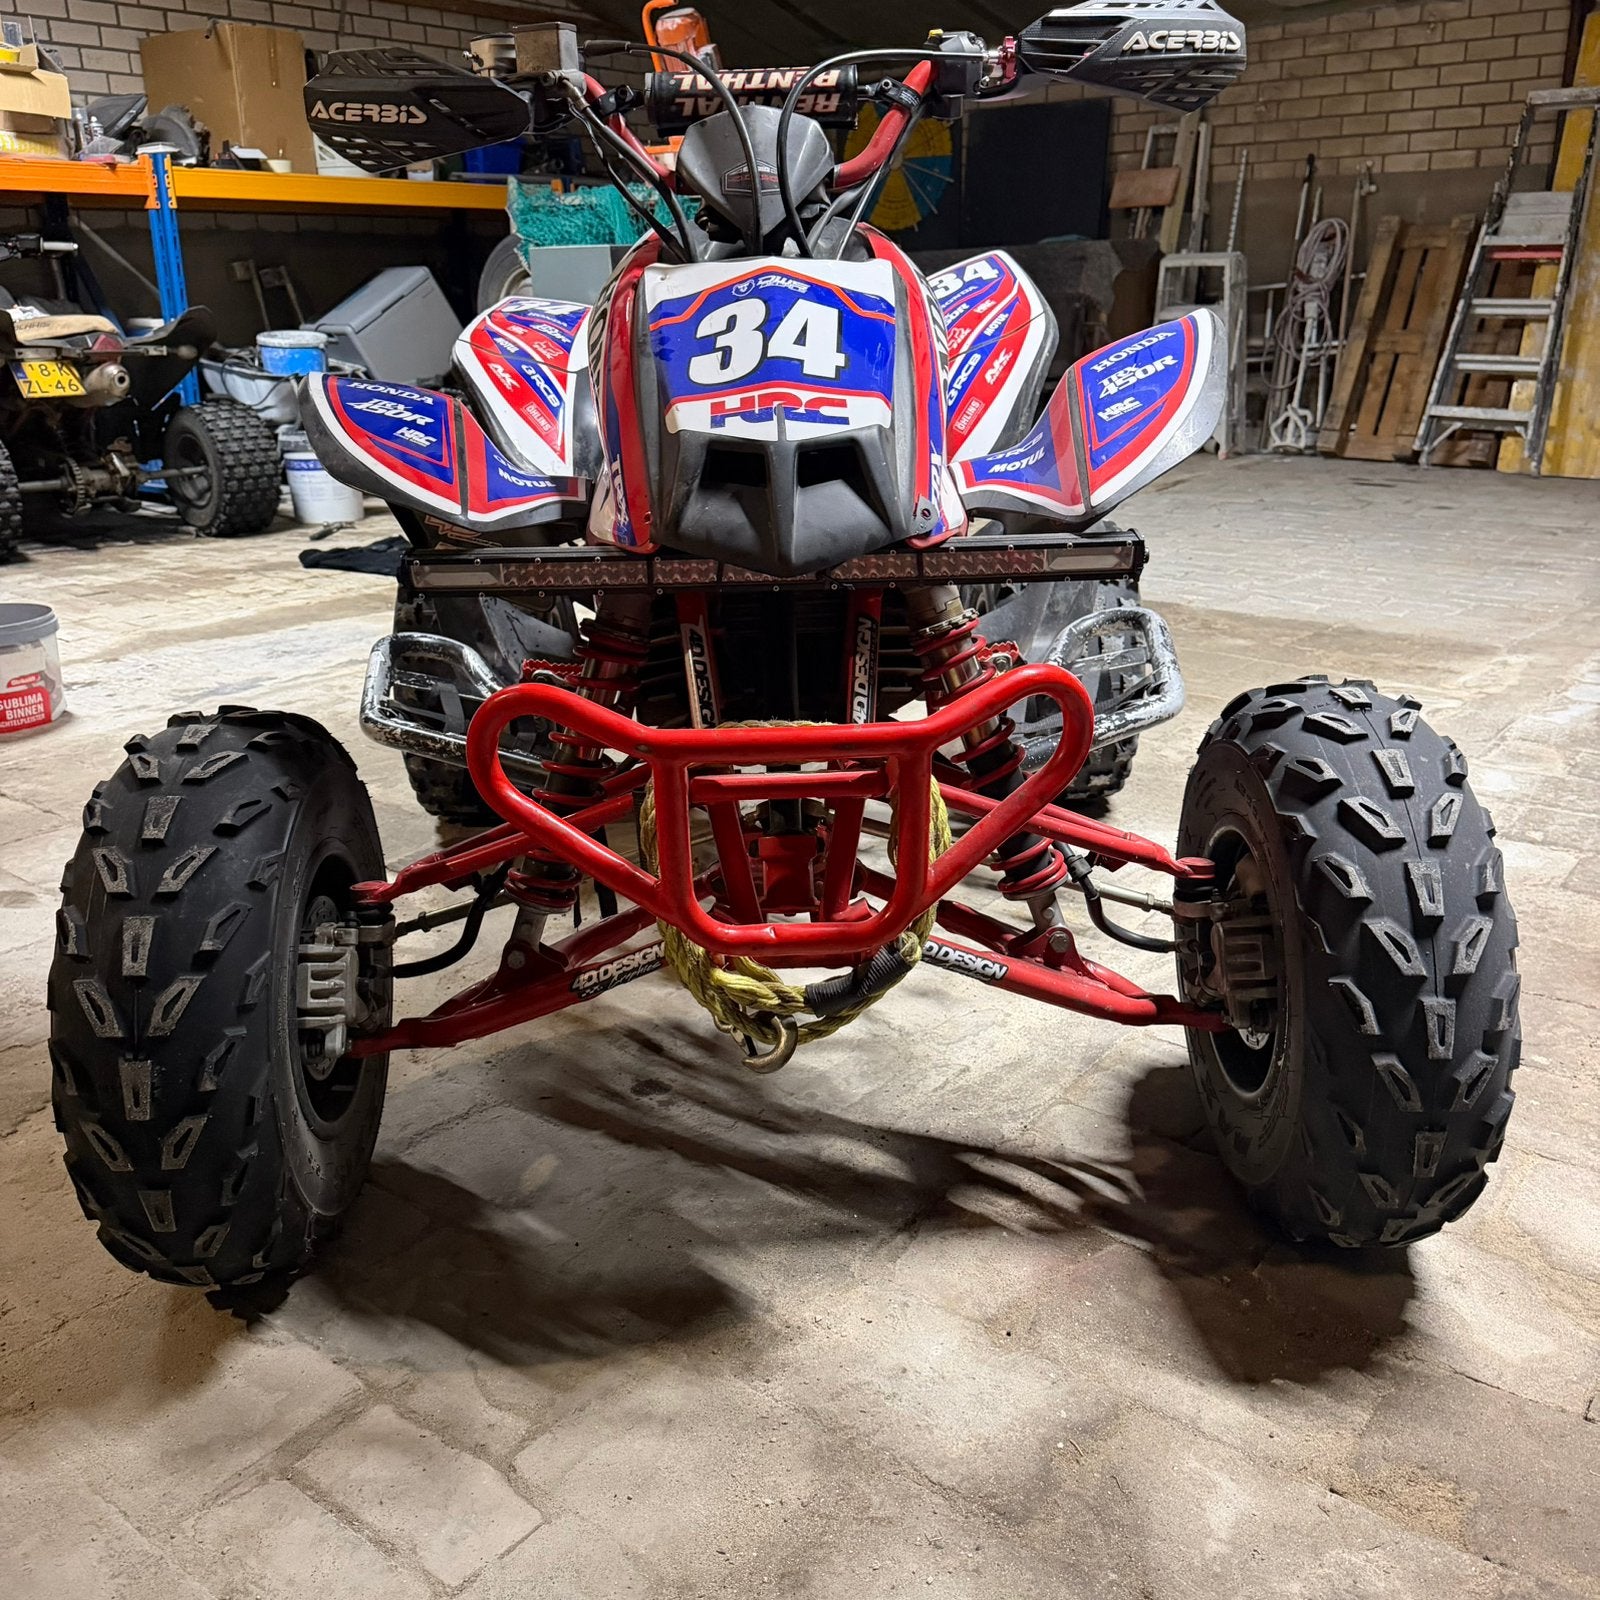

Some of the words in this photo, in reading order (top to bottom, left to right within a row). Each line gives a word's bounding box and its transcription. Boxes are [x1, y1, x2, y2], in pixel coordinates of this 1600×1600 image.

[673, 69, 842, 91] RNTHAL
[688, 298, 847, 386] 34
[1090, 332, 1177, 372] HONDA
[23, 379, 80, 394] ZL-46
[1098, 364, 1137, 385] TRX
[1099, 355, 1179, 399] 450R
[346, 382, 434, 405] HONDA
[345, 402, 435, 426] 450R
[711, 391, 851, 429] HRC
[988, 446, 1046, 474] MOTUL
[498, 467, 557, 488] MOTUL
[855, 616, 873, 697] DESIGN
[0, 692, 44, 710] SUBLIMA
[6, 703, 45, 720] BINNEN
[600, 940, 666, 981] DESIGN
[936, 945, 1008, 980] DESIGN
